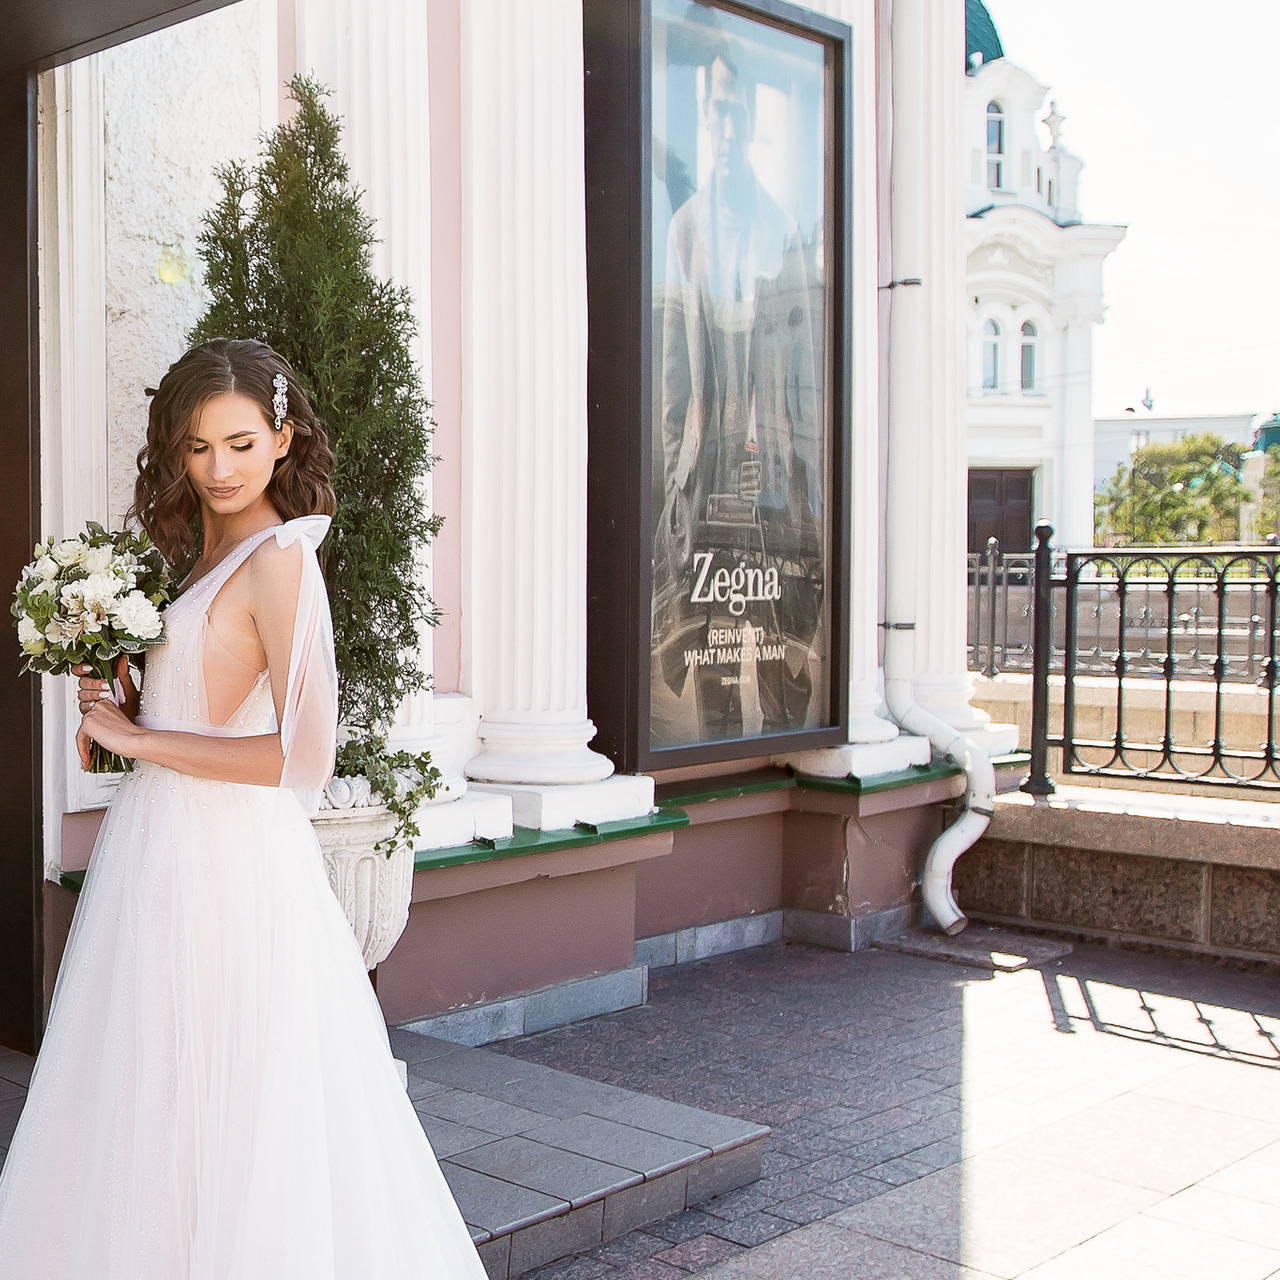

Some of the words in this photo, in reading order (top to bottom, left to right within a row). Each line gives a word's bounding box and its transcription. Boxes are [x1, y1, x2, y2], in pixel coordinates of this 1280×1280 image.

[690, 552, 781, 616] Zegna
[708, 626, 765, 647] (REINVENT)
[684, 648, 716, 667] WHAT
[717, 647, 753, 665] MAKES
[754, 646, 761, 662] A
[762, 645, 786, 661] MAN
